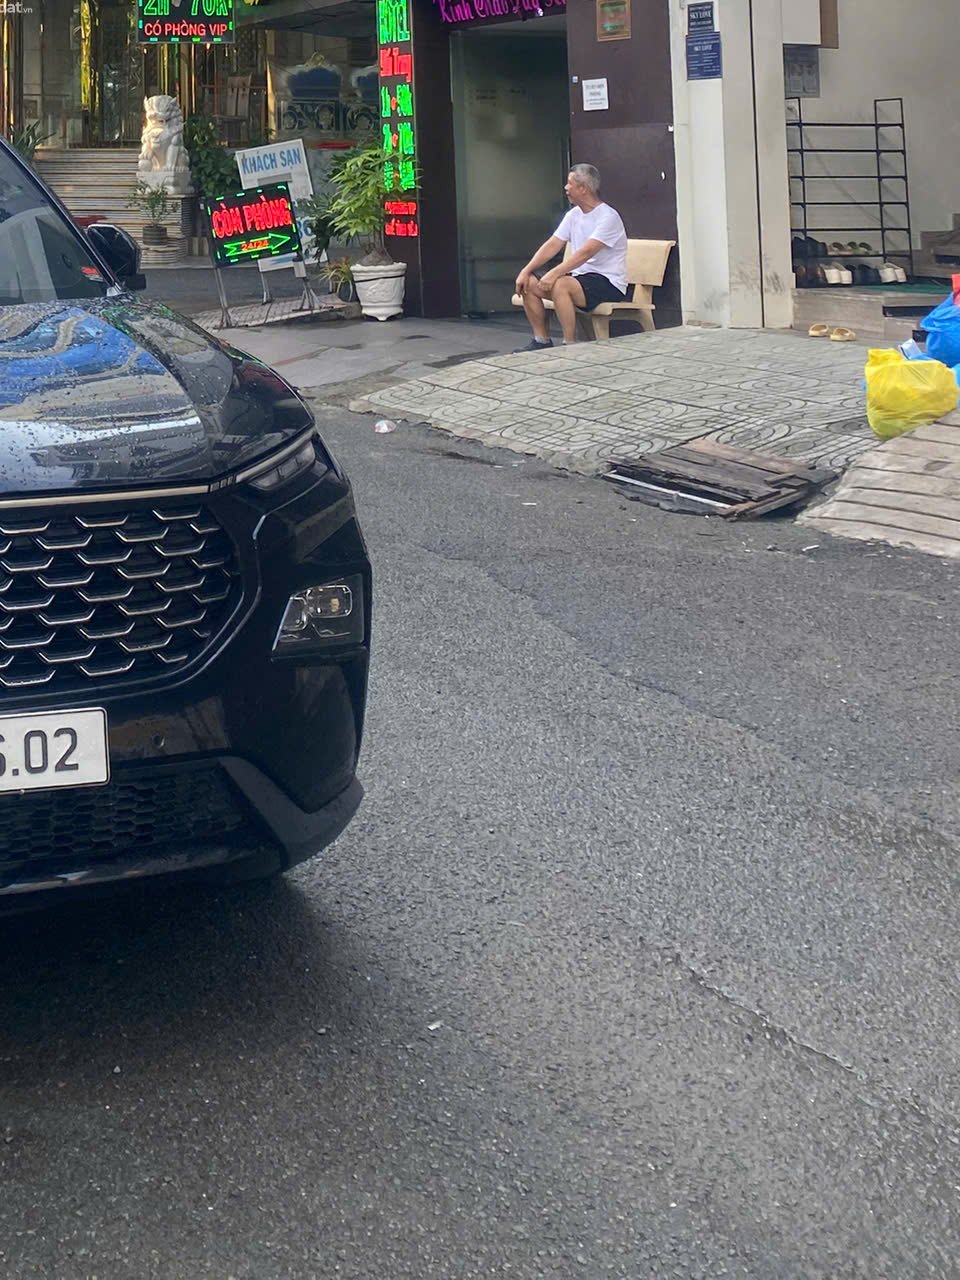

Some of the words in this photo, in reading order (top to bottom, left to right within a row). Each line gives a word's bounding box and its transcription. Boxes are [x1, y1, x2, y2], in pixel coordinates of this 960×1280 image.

[144, 20, 162, 36] CÓ
[164, 21, 206, 37] PHÒNG
[208, 23, 228, 36] VIP
[241, 151, 278, 175] KHÁCH
[280, 147, 302, 170] SẠN
[242, 195, 293, 232] PHÒNG
